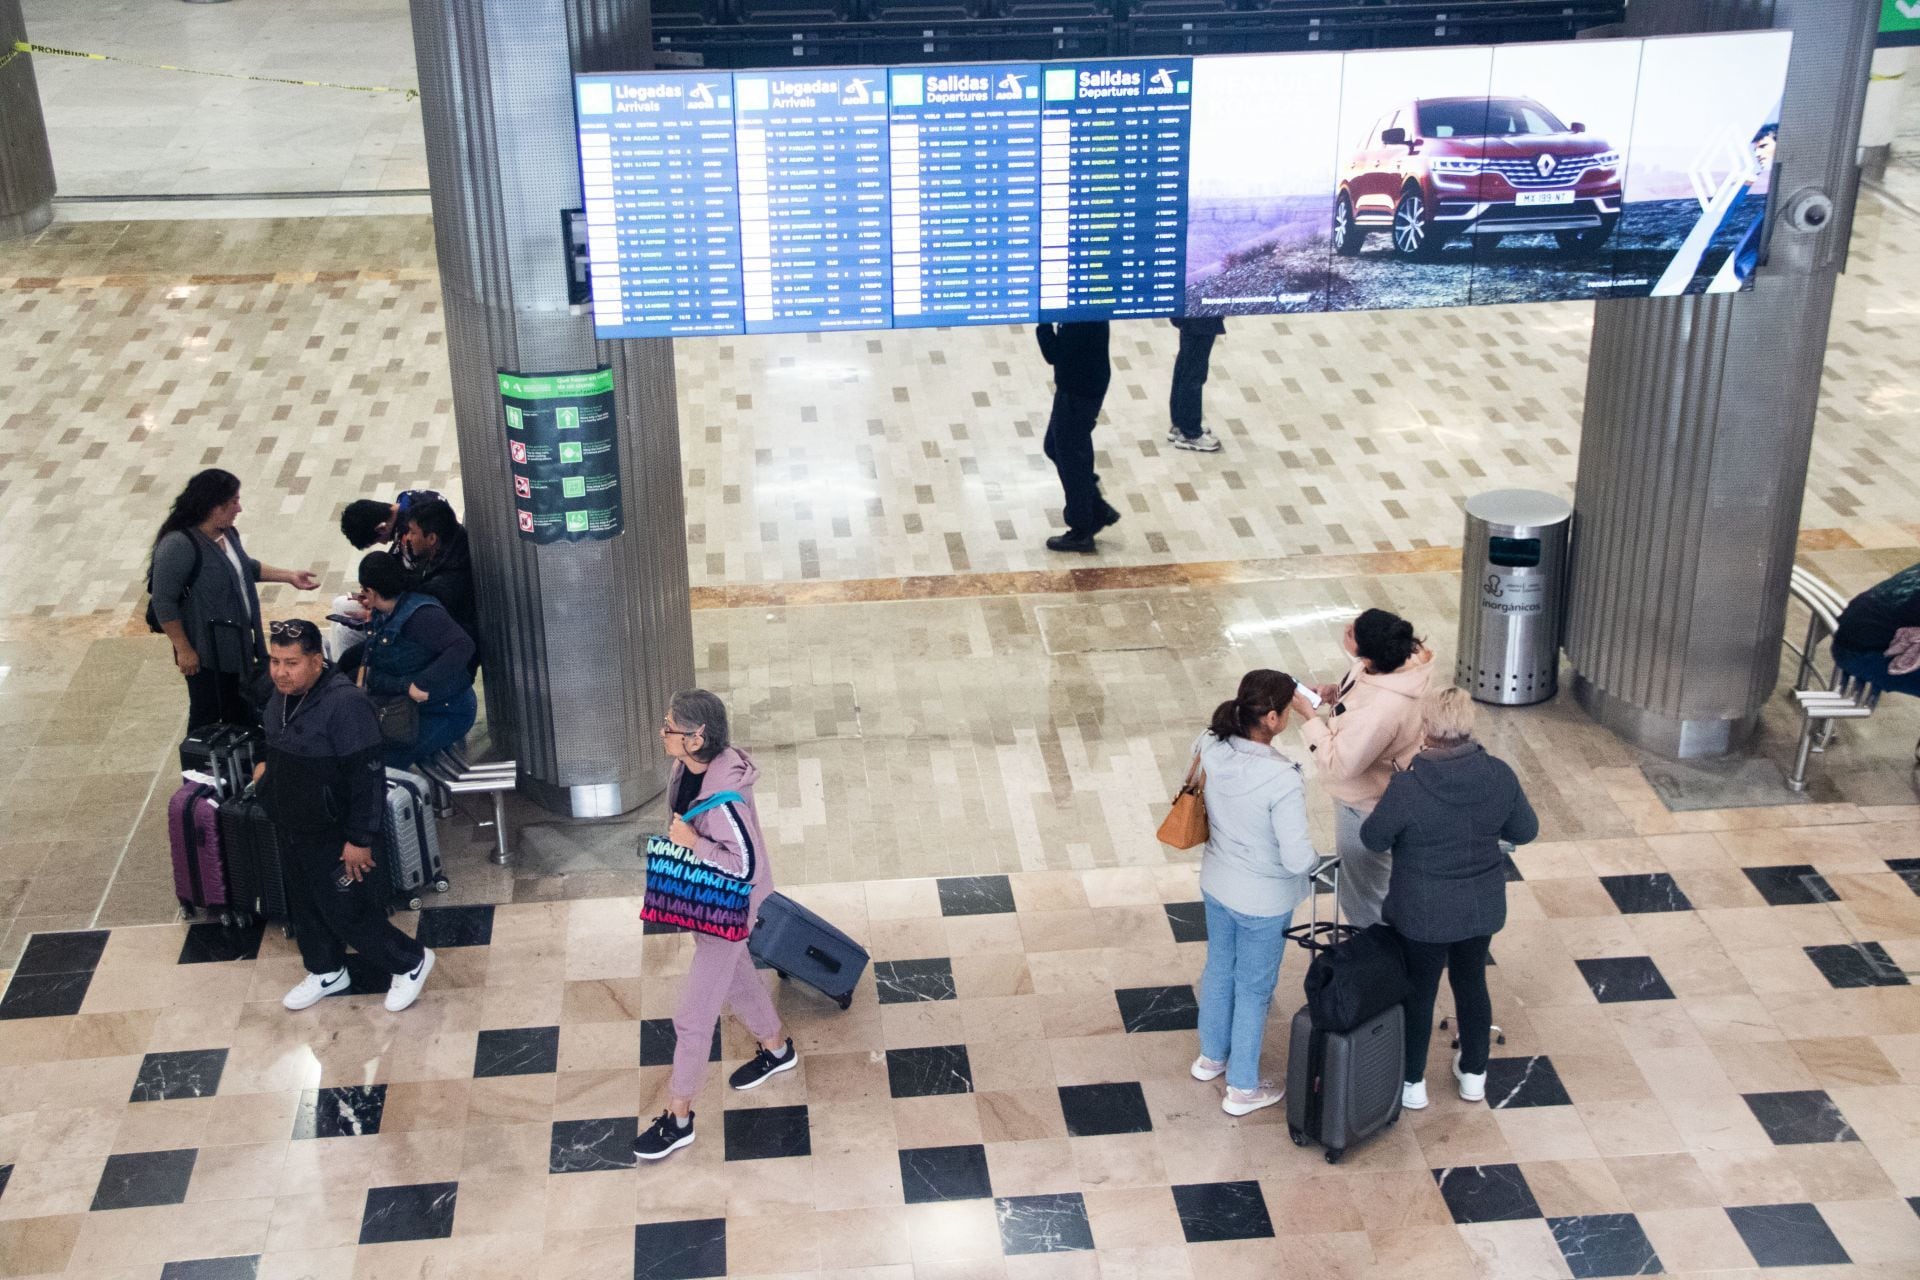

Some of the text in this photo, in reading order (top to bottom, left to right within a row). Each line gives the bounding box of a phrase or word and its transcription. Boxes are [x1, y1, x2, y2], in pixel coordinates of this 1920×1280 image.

[31, 44, 90, 57] PROHIBIDO
[927, 76, 988, 91] Salidas
[1079, 70, 1140, 86] Salidas
[615, 84, 682, 100] Llegadas
[772, 80, 837, 96] Llegadas
[1080, 87, 1140, 98] Departures
[773, 97, 815, 108] Arrivals
[927, 92, 988, 104] Departures
[617, 102, 660, 112] Arrivals
[1482, 598, 1541, 613] inorgánicos
[651, 858, 684, 878] MIAMI
[684, 866, 724, 888] MIAMI
[657, 876, 694, 899] MIAMI
[695, 887, 736, 909] MIAMI
[666, 897, 704, 920] MIAMI
